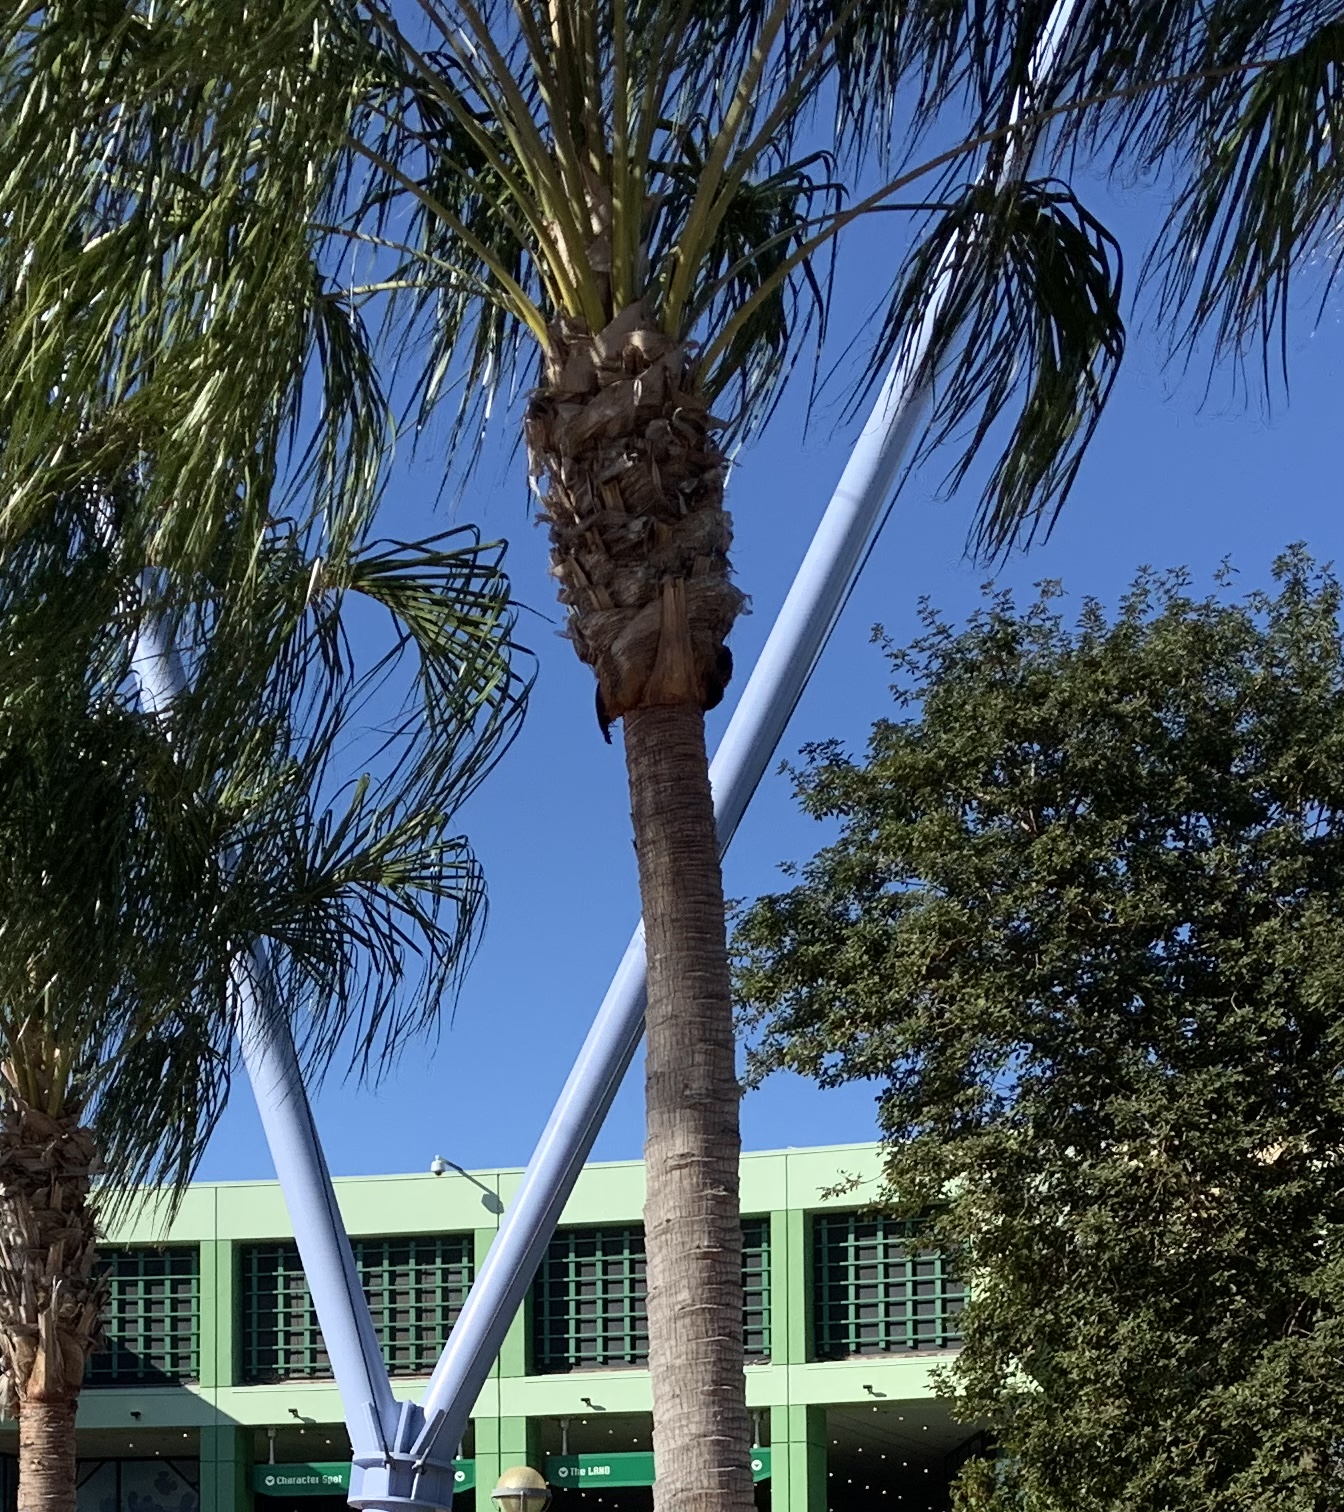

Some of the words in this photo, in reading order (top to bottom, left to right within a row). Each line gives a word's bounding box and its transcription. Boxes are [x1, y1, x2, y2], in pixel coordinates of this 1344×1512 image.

[570, 1467, 586, 1476] The
[588, 1466, 611, 1476] LAND
[276, 1475, 319, 1485] Character
[322, 1474, 343, 1485] Spot
